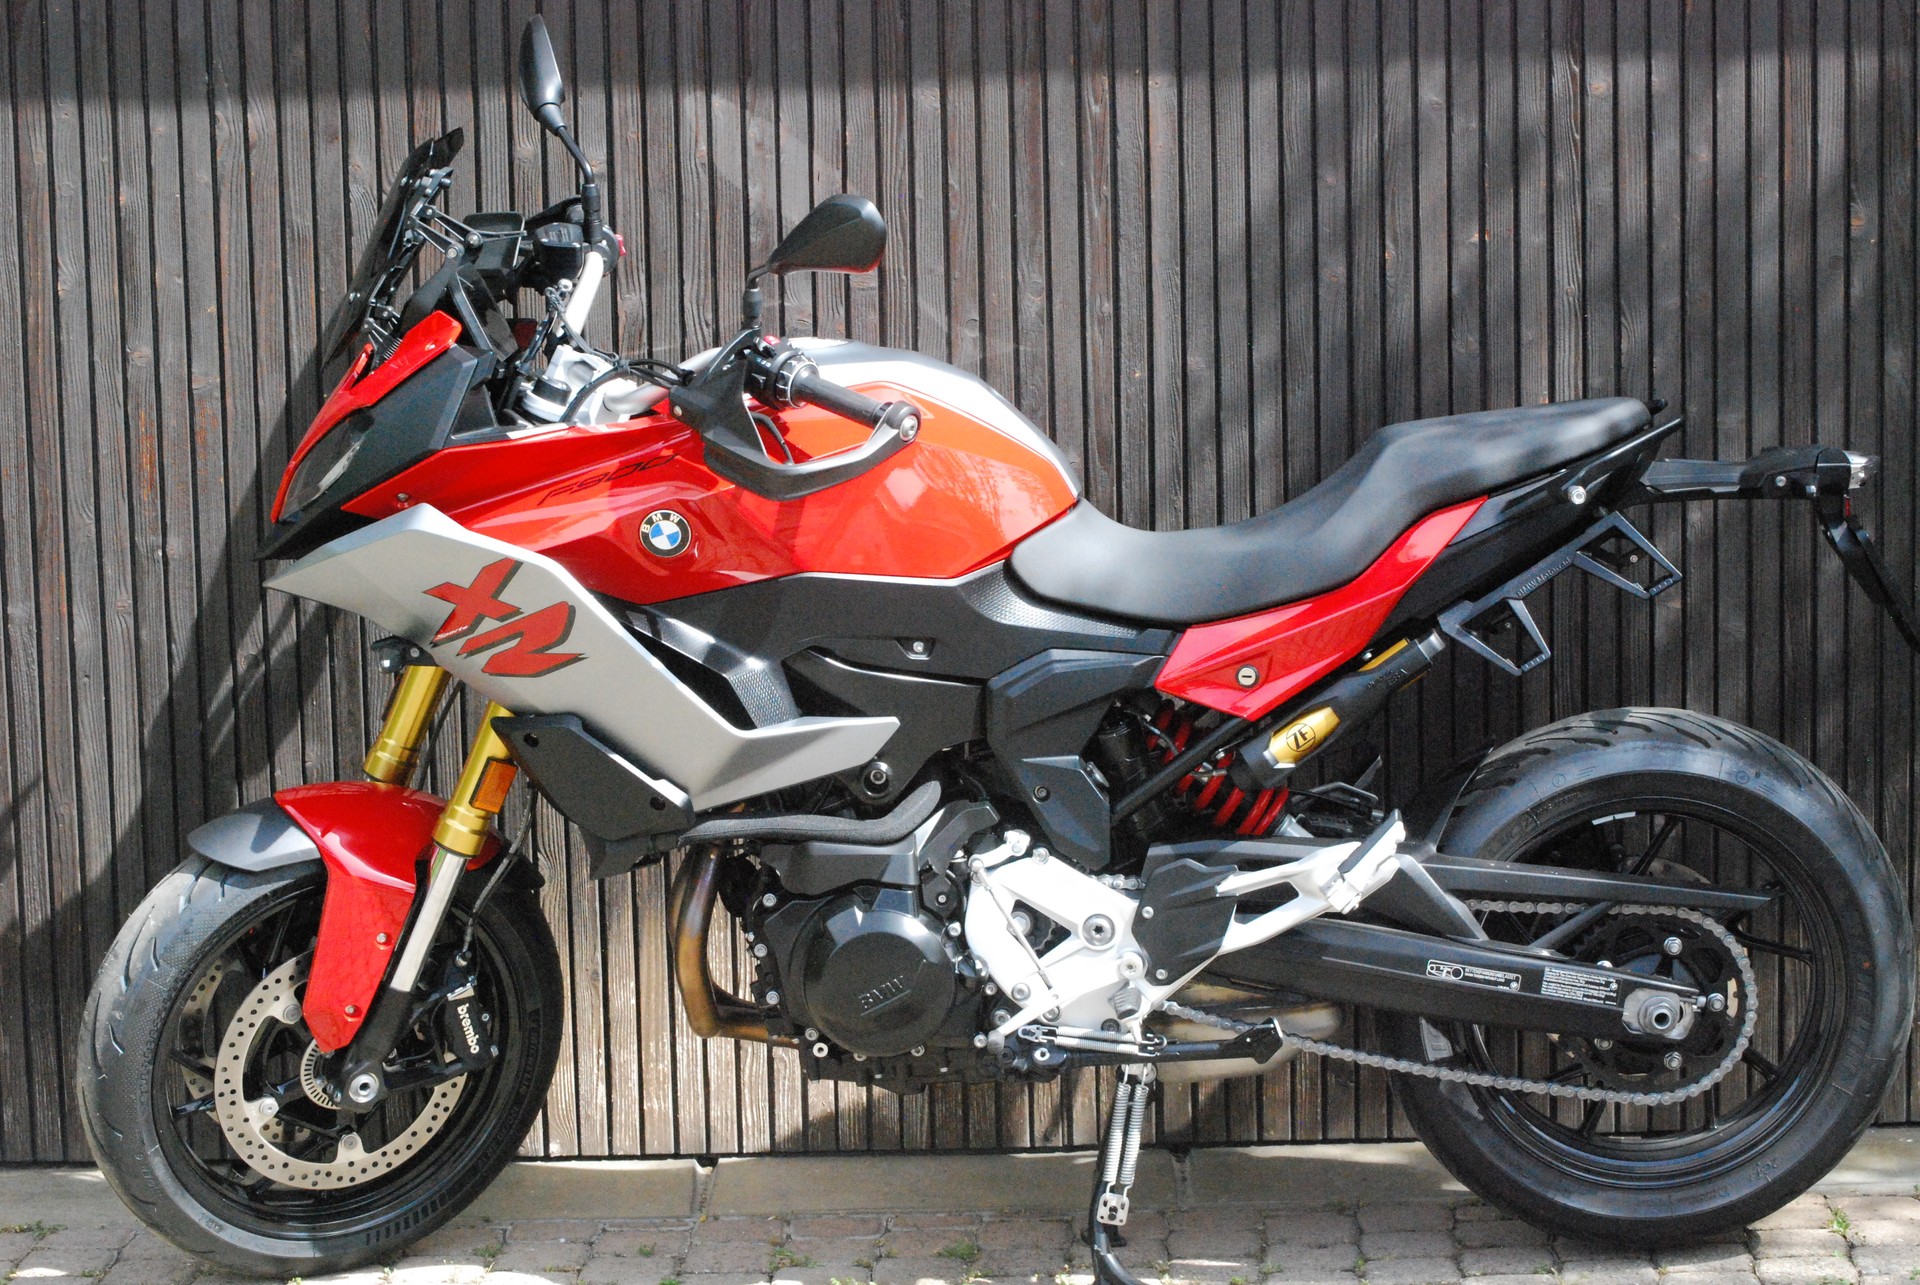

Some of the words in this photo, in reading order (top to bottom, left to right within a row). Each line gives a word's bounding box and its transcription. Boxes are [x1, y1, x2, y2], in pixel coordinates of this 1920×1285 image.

[640, 512, 681, 534] BMW
[1286, 723, 1316, 751] ZF
[857, 974, 905, 1010] BMW
[457, 1003, 480, 1054] brembo
